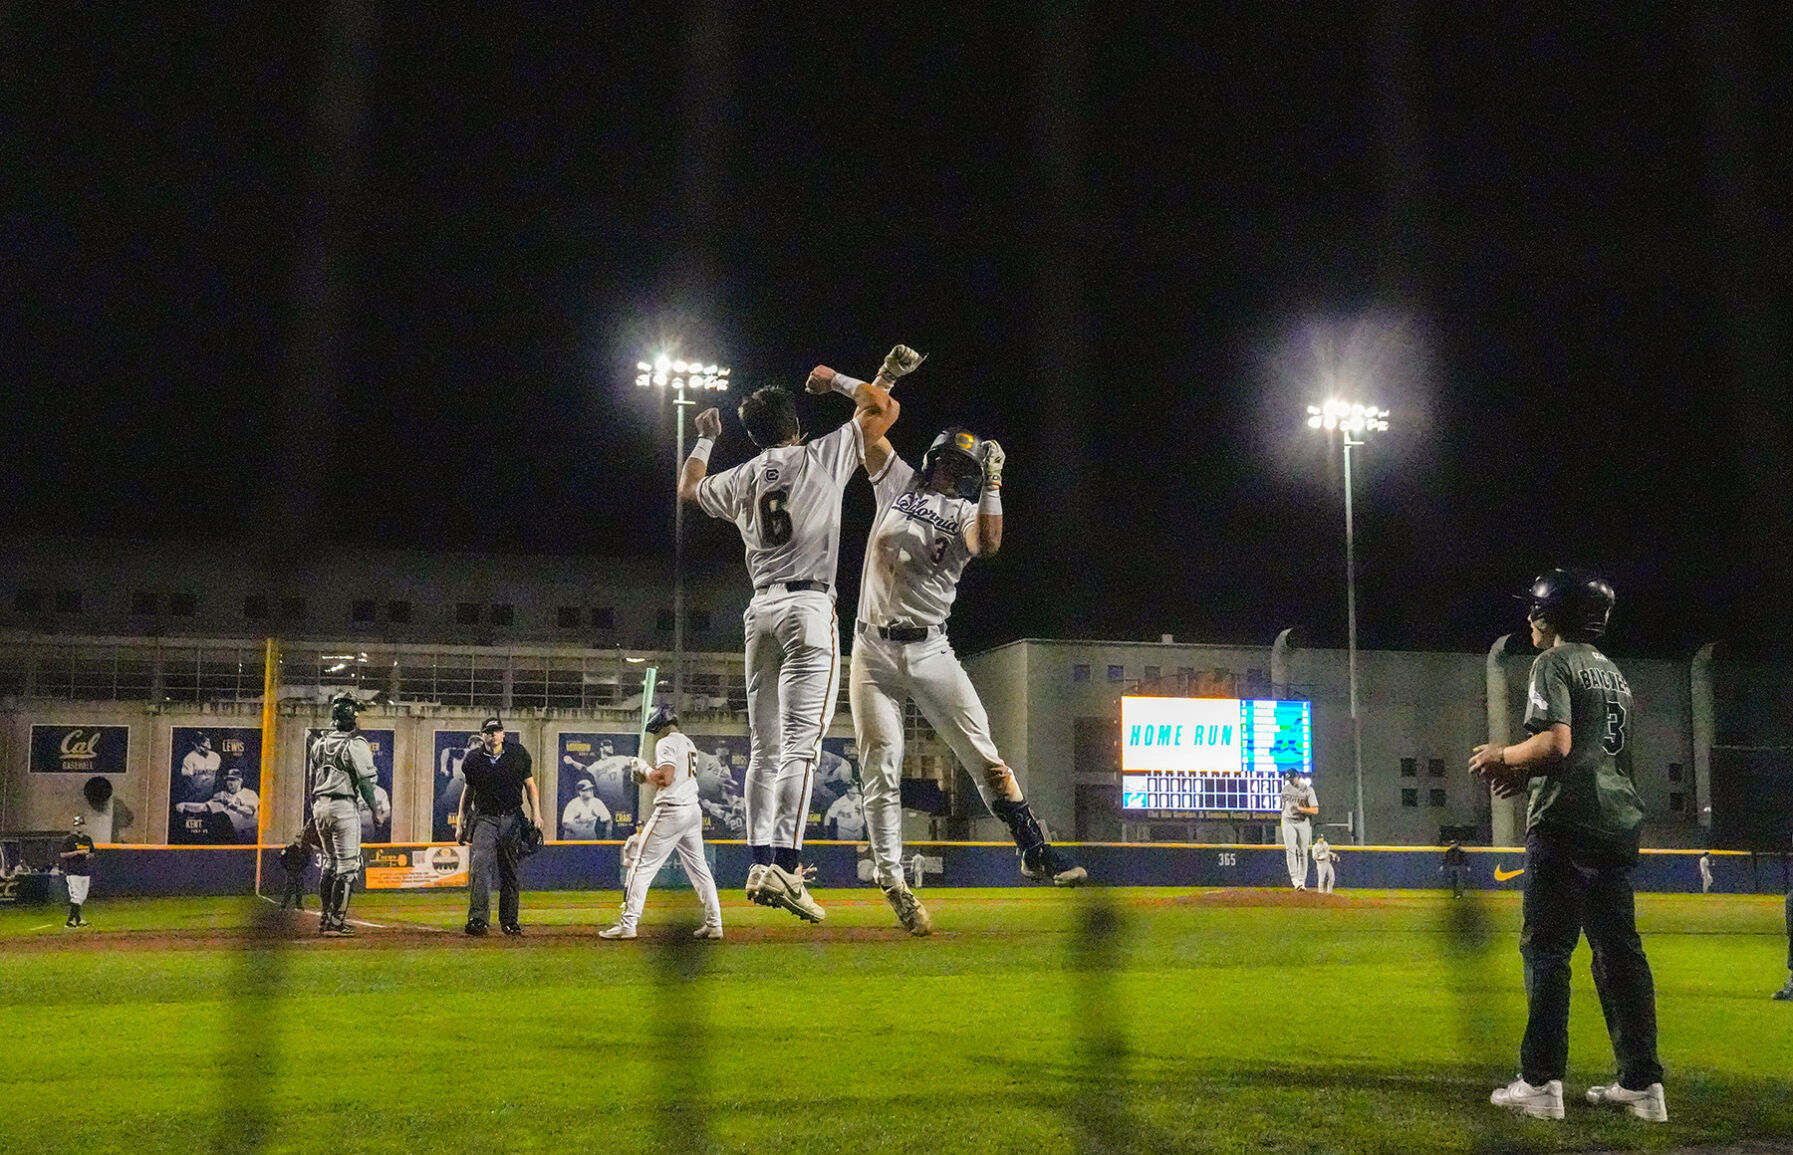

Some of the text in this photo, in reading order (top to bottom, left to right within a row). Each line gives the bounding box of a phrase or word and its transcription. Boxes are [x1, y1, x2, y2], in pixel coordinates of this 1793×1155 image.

[760, 488, 793, 547] 6
[1129, 724, 1233, 746] HOME RUN
[1601, 701, 1626, 756] 3
[60, 729, 101, 759] Cal
[222, 740, 245, 752] LEWIS
[1149, 779, 1156, 792] 0
[1160, 779, 1167, 792] 0
[1172, 779, 1179, 792] 0
[1183, 780, 1191, 792] 4
[1195, 780, 1202, 793] 0
[1252, 781, 1259, 794] 4
[1262, 781, 1270, 794] 2
[1149, 794, 1156, 807] 0
[1160, 794, 1167, 807] 0
[1172, 794, 1179, 808] 0
[1184, 795, 1191, 808] 0
[1263, 796, 1270, 809] 4
[1274, 796, 1281, 809] 3
[185, 819, 203, 829] KENT
[730, 817, 743, 830] 20
[1218, 853, 1236, 866] 365
